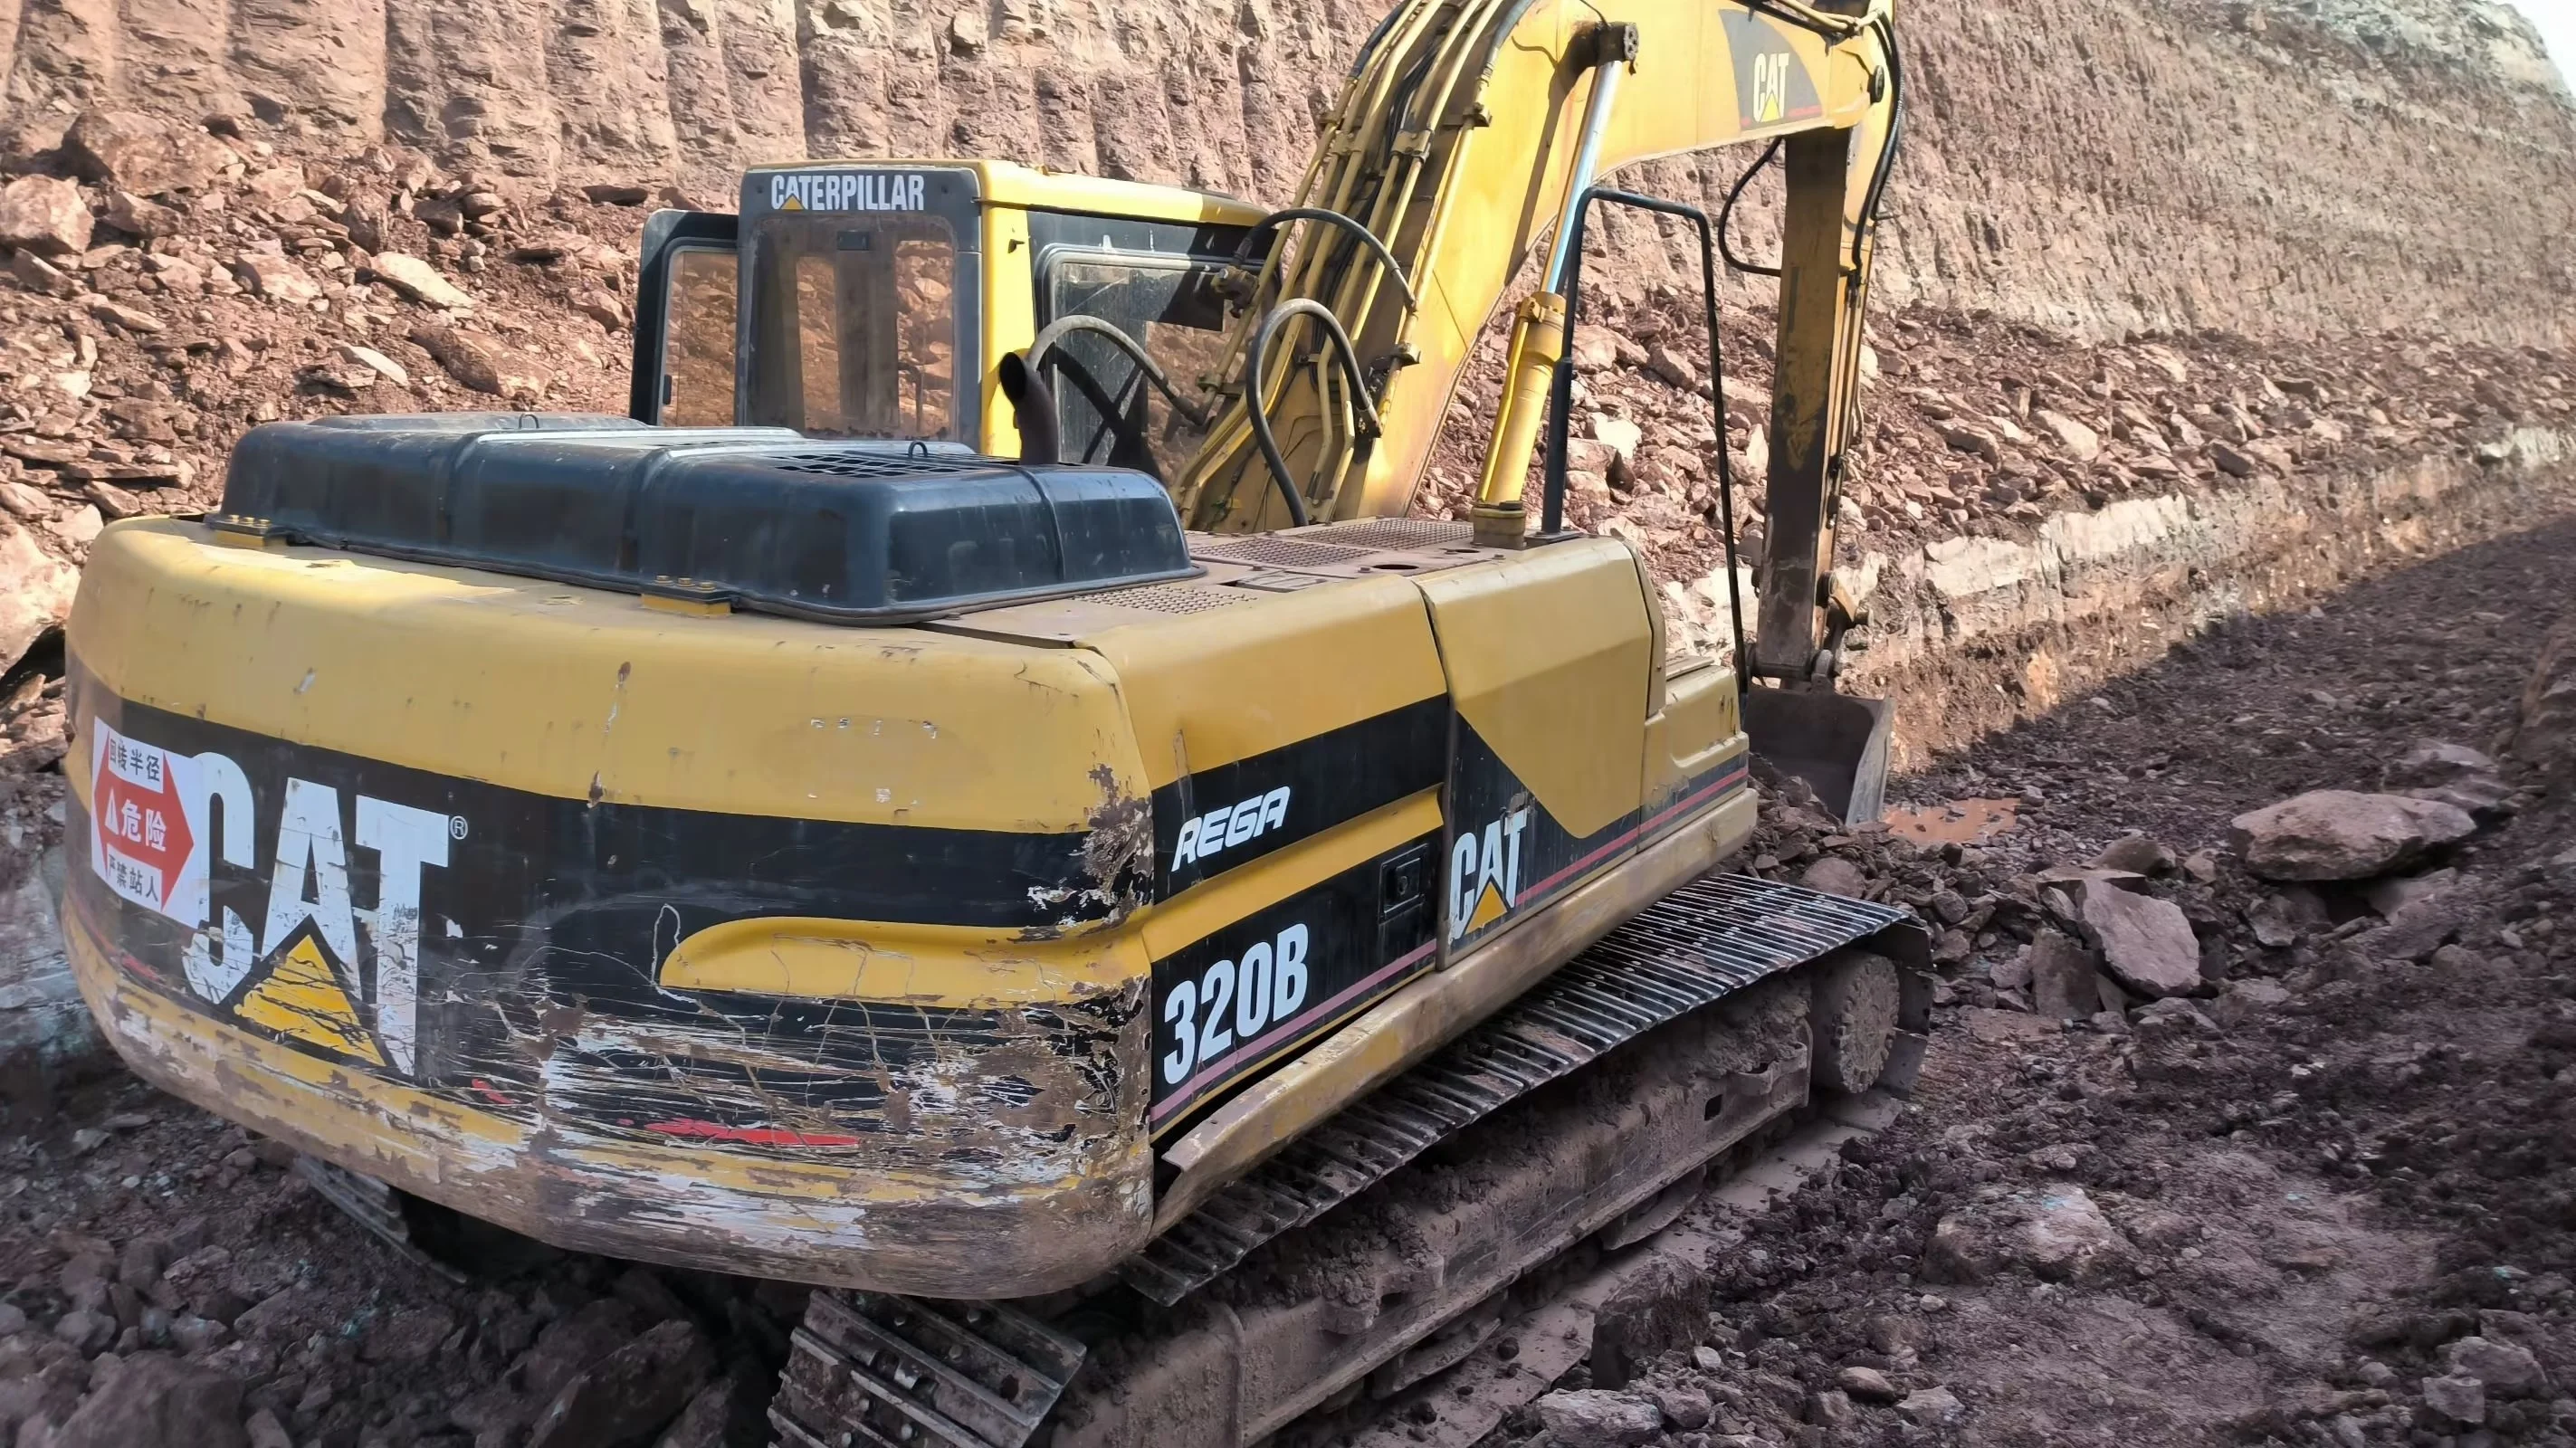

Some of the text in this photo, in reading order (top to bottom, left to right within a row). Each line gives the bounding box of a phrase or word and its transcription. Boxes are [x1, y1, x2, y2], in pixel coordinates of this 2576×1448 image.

[1753, 52, 1789, 122] CAT
[771, 175, 924, 211] CATERPILLAR
[110, 738, 160, 782] 回转半径
[121, 798, 167, 852] 危险
[1171, 786, 1291, 872] REGA
[108, 853, 158, 902] 严禁站人
[1448, 808, 1528, 940] CAT
[1163, 923, 1309, 1085] 320B
